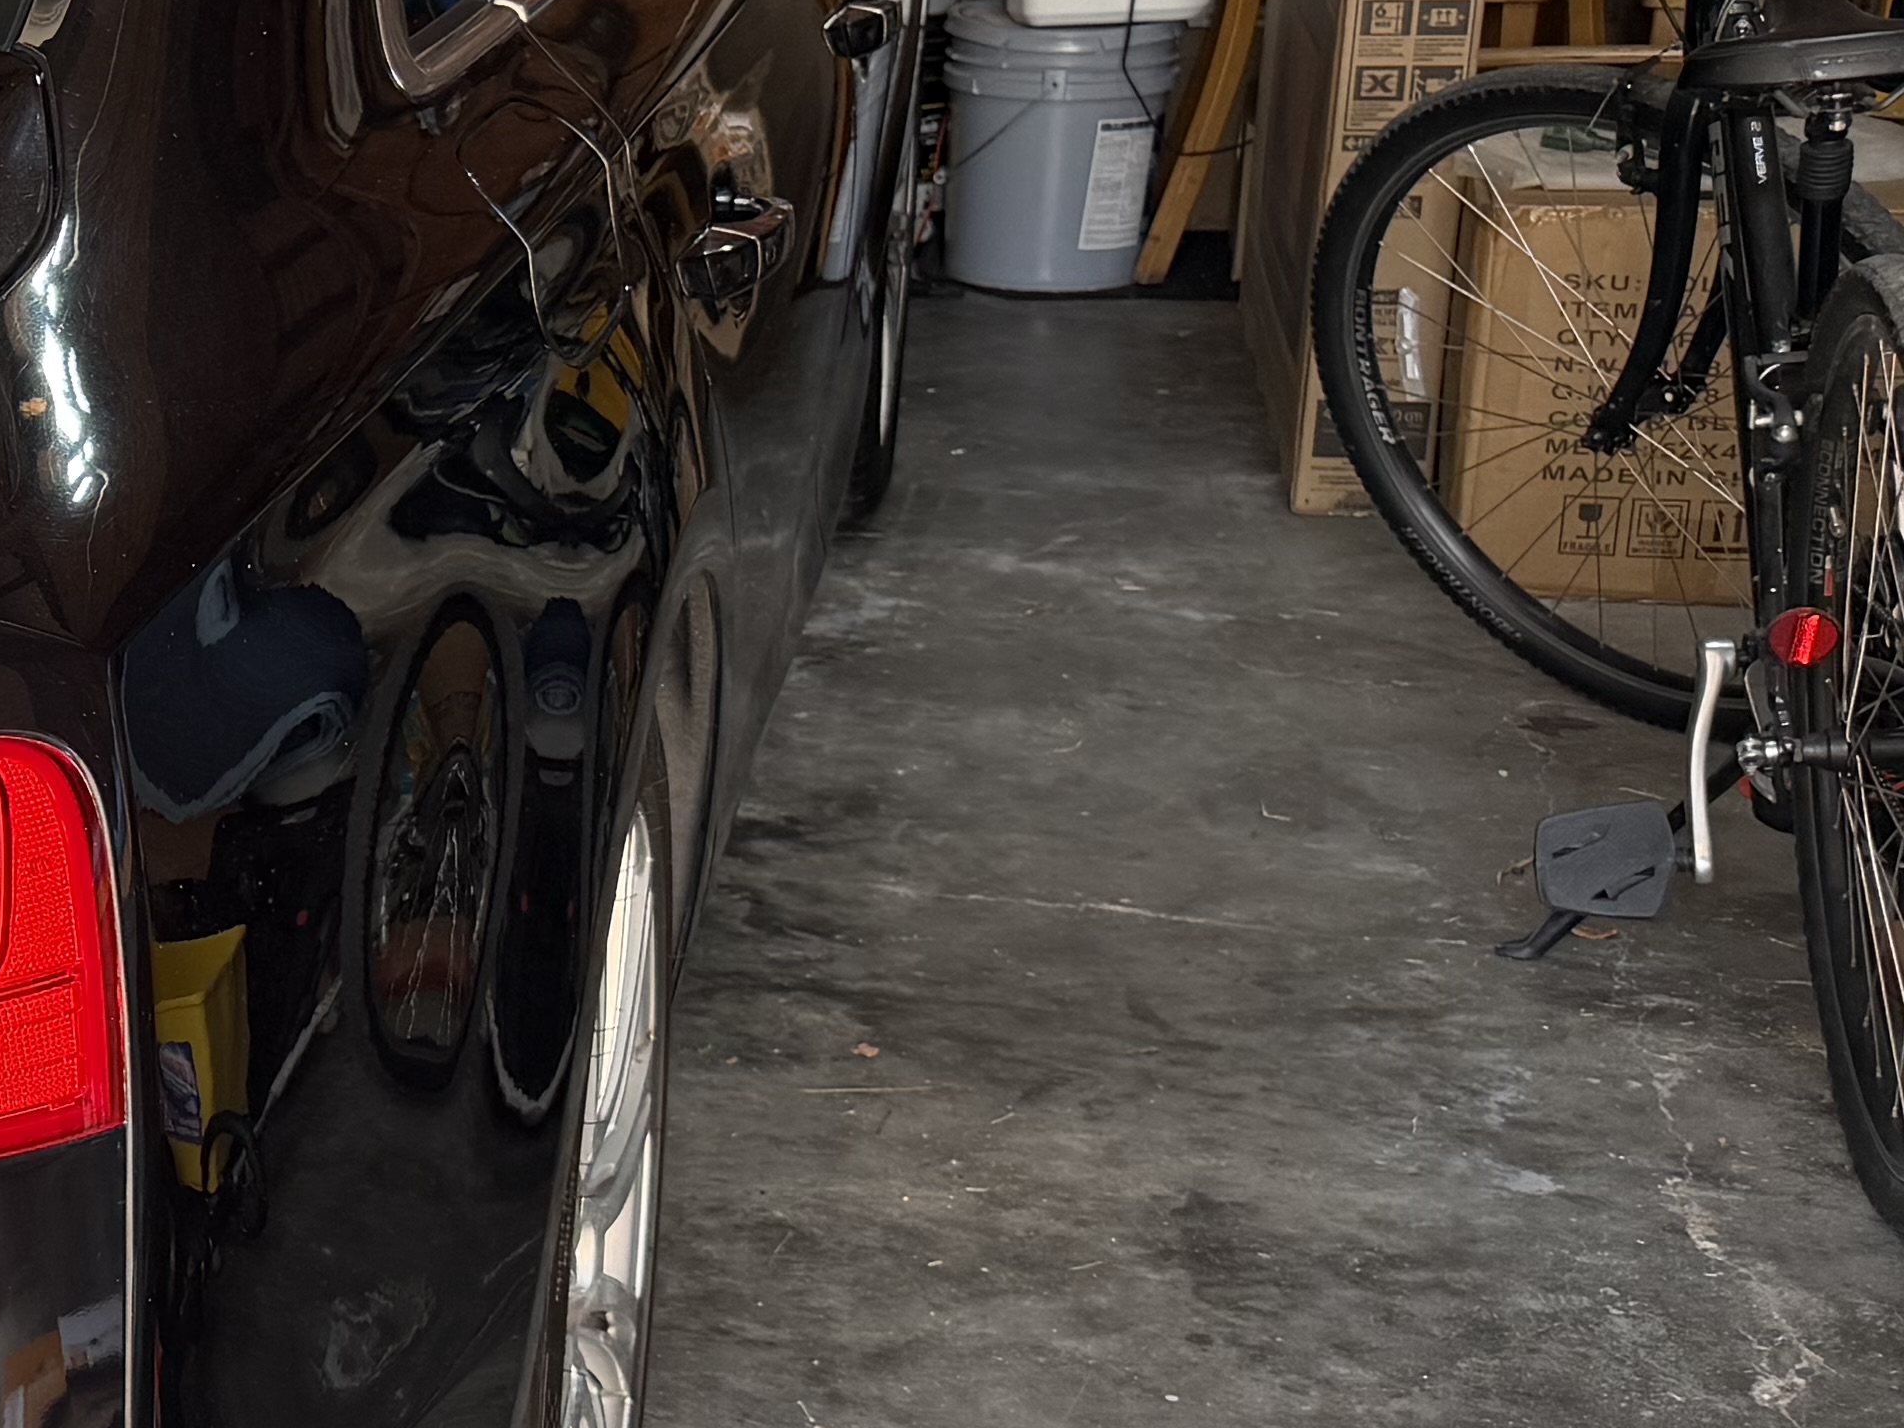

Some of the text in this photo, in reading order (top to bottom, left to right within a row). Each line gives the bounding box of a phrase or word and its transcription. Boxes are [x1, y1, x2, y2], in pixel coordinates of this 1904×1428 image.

[1375, 2, 1387, 18] 6
[1753, 136, 1768, 185] VERVE
[1564, 273, 1641, 292] SKU:
[1353, 287, 1396, 446] BONTRAGER
[1542, 464, 1635, 484] MADE
[1656, 470, 1687, 486] IN
[1809, 449, 1834, 586] CONNECTION
